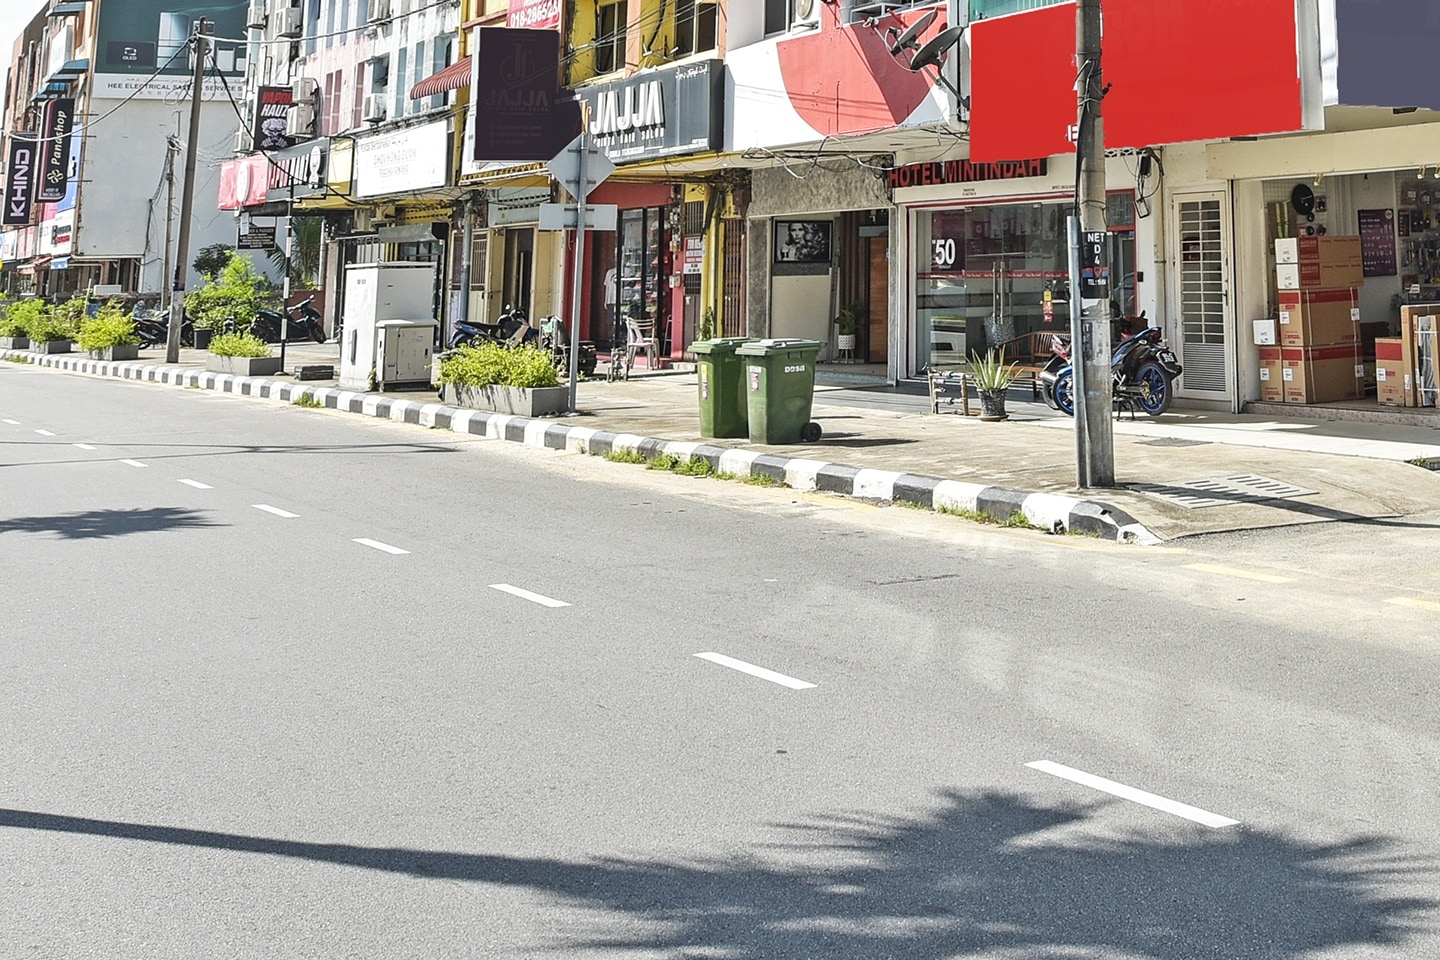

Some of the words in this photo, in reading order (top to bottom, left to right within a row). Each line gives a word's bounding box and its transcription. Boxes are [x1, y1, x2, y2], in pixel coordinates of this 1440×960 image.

[591, 80, 664, 135] JAJJA
[51, 110, 67, 166] Panashop
[10, 148, 31, 217] KHIND
[889, 162, 941, 188] HOTEL
[935, 238, 956, 265] 50
[1087, 233, 1105, 242] NET
